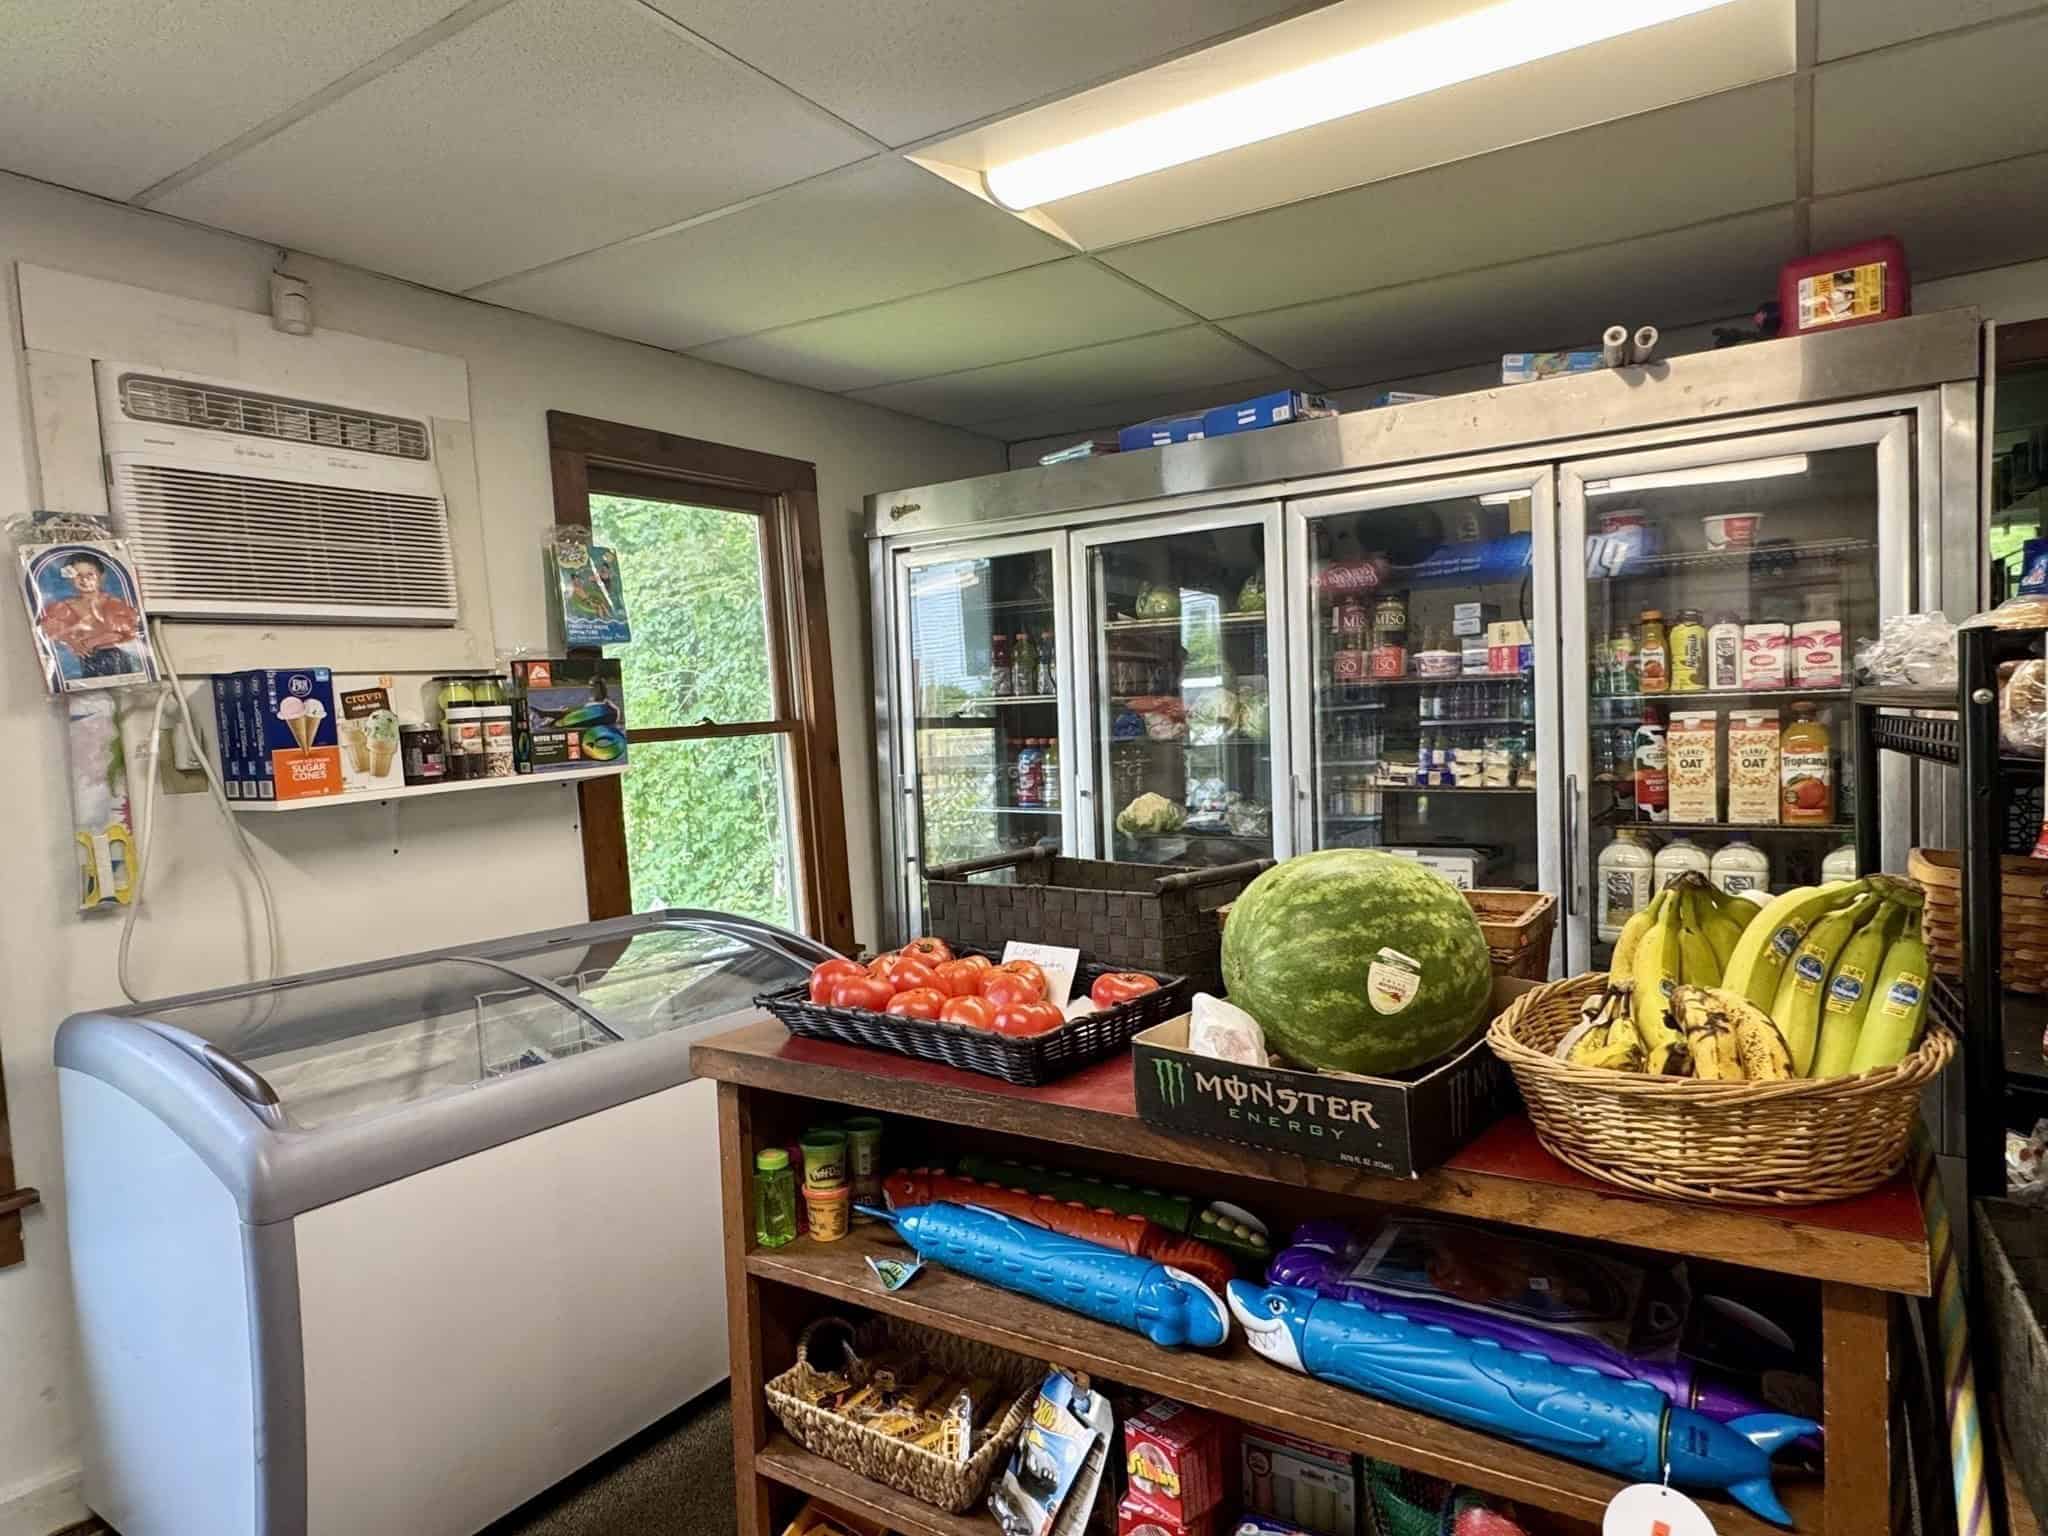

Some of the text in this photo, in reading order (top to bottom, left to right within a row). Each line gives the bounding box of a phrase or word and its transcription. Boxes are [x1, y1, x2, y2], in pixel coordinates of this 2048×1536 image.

[1343, 615, 1368, 628] MIS
[1375, 614, 1405, 625] MISO
[1335, 660, 1357, 673] ISO
[292, 761, 327, 773] SUGAR
[1679, 758, 1704, 768] OAT
[1742, 758, 1767, 768] OAT
[1783, 756, 1827, 768] Tropicana
[292, 770, 327, 782] CONES
[1194, 1071, 1380, 1130] MONSTER
[1228, 1108, 1344, 1140] ENERGY
